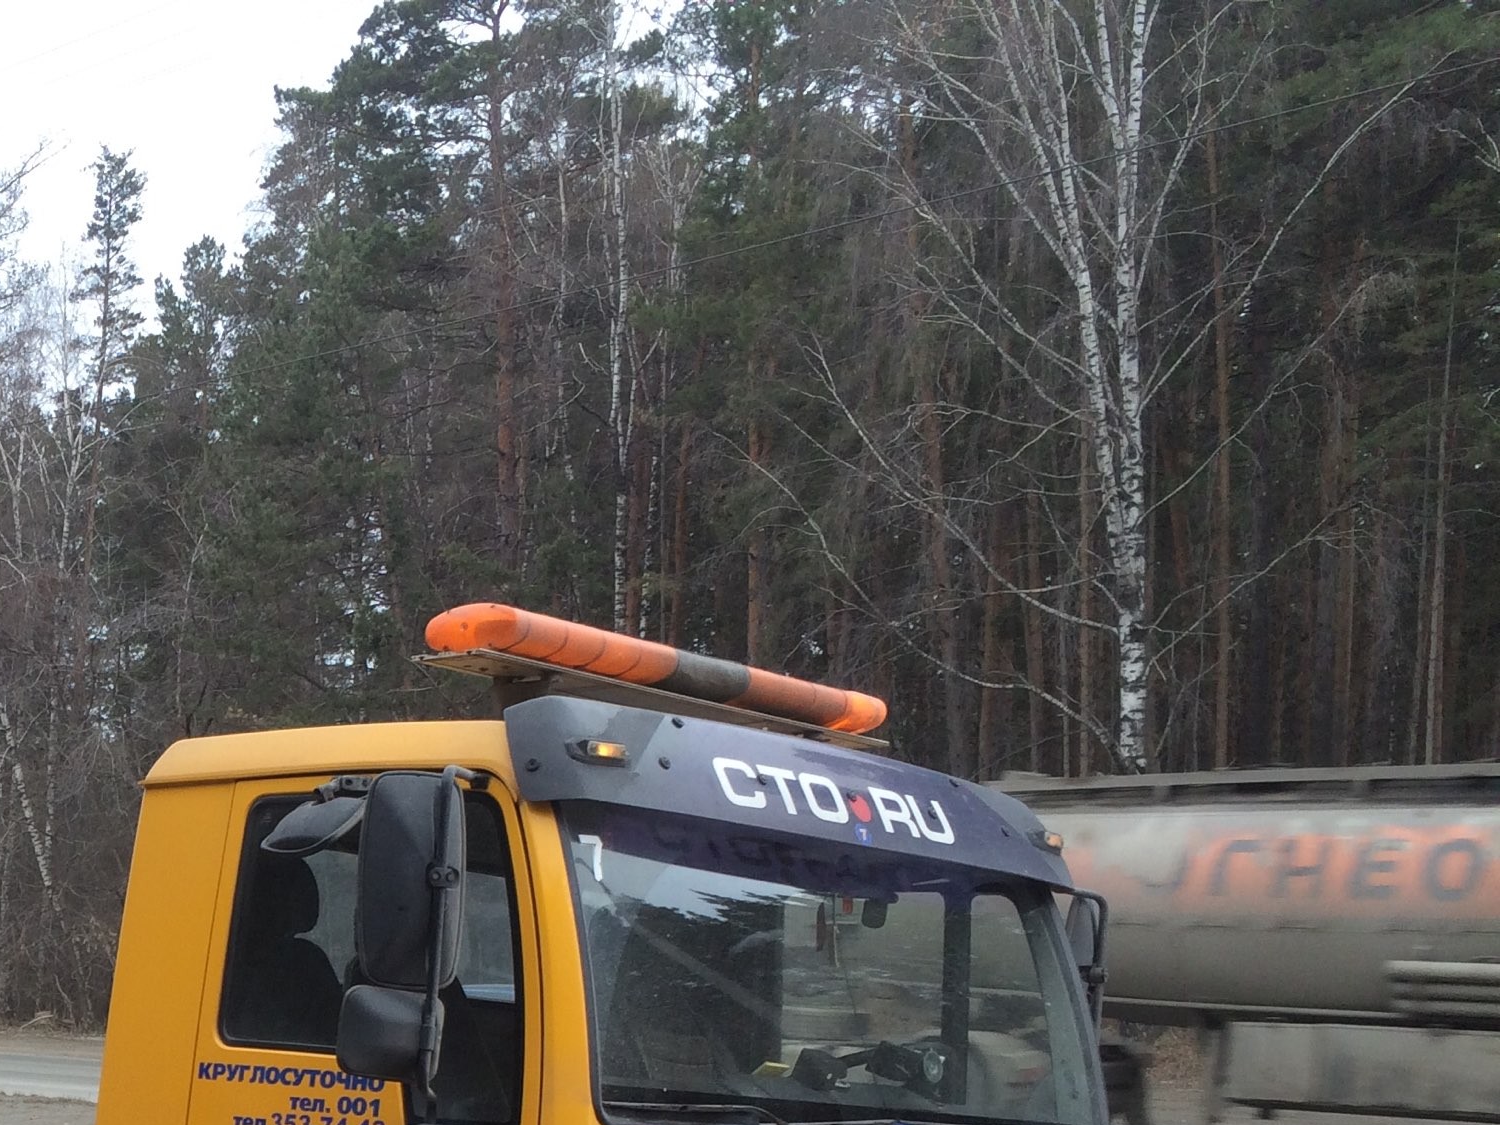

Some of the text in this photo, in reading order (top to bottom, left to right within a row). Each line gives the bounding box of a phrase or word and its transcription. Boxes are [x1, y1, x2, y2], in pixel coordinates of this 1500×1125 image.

[198, 1062, 385, 1092] КРУГЛОСУТОЧНО
[289, 1096, 380, 1117] тел. 001
